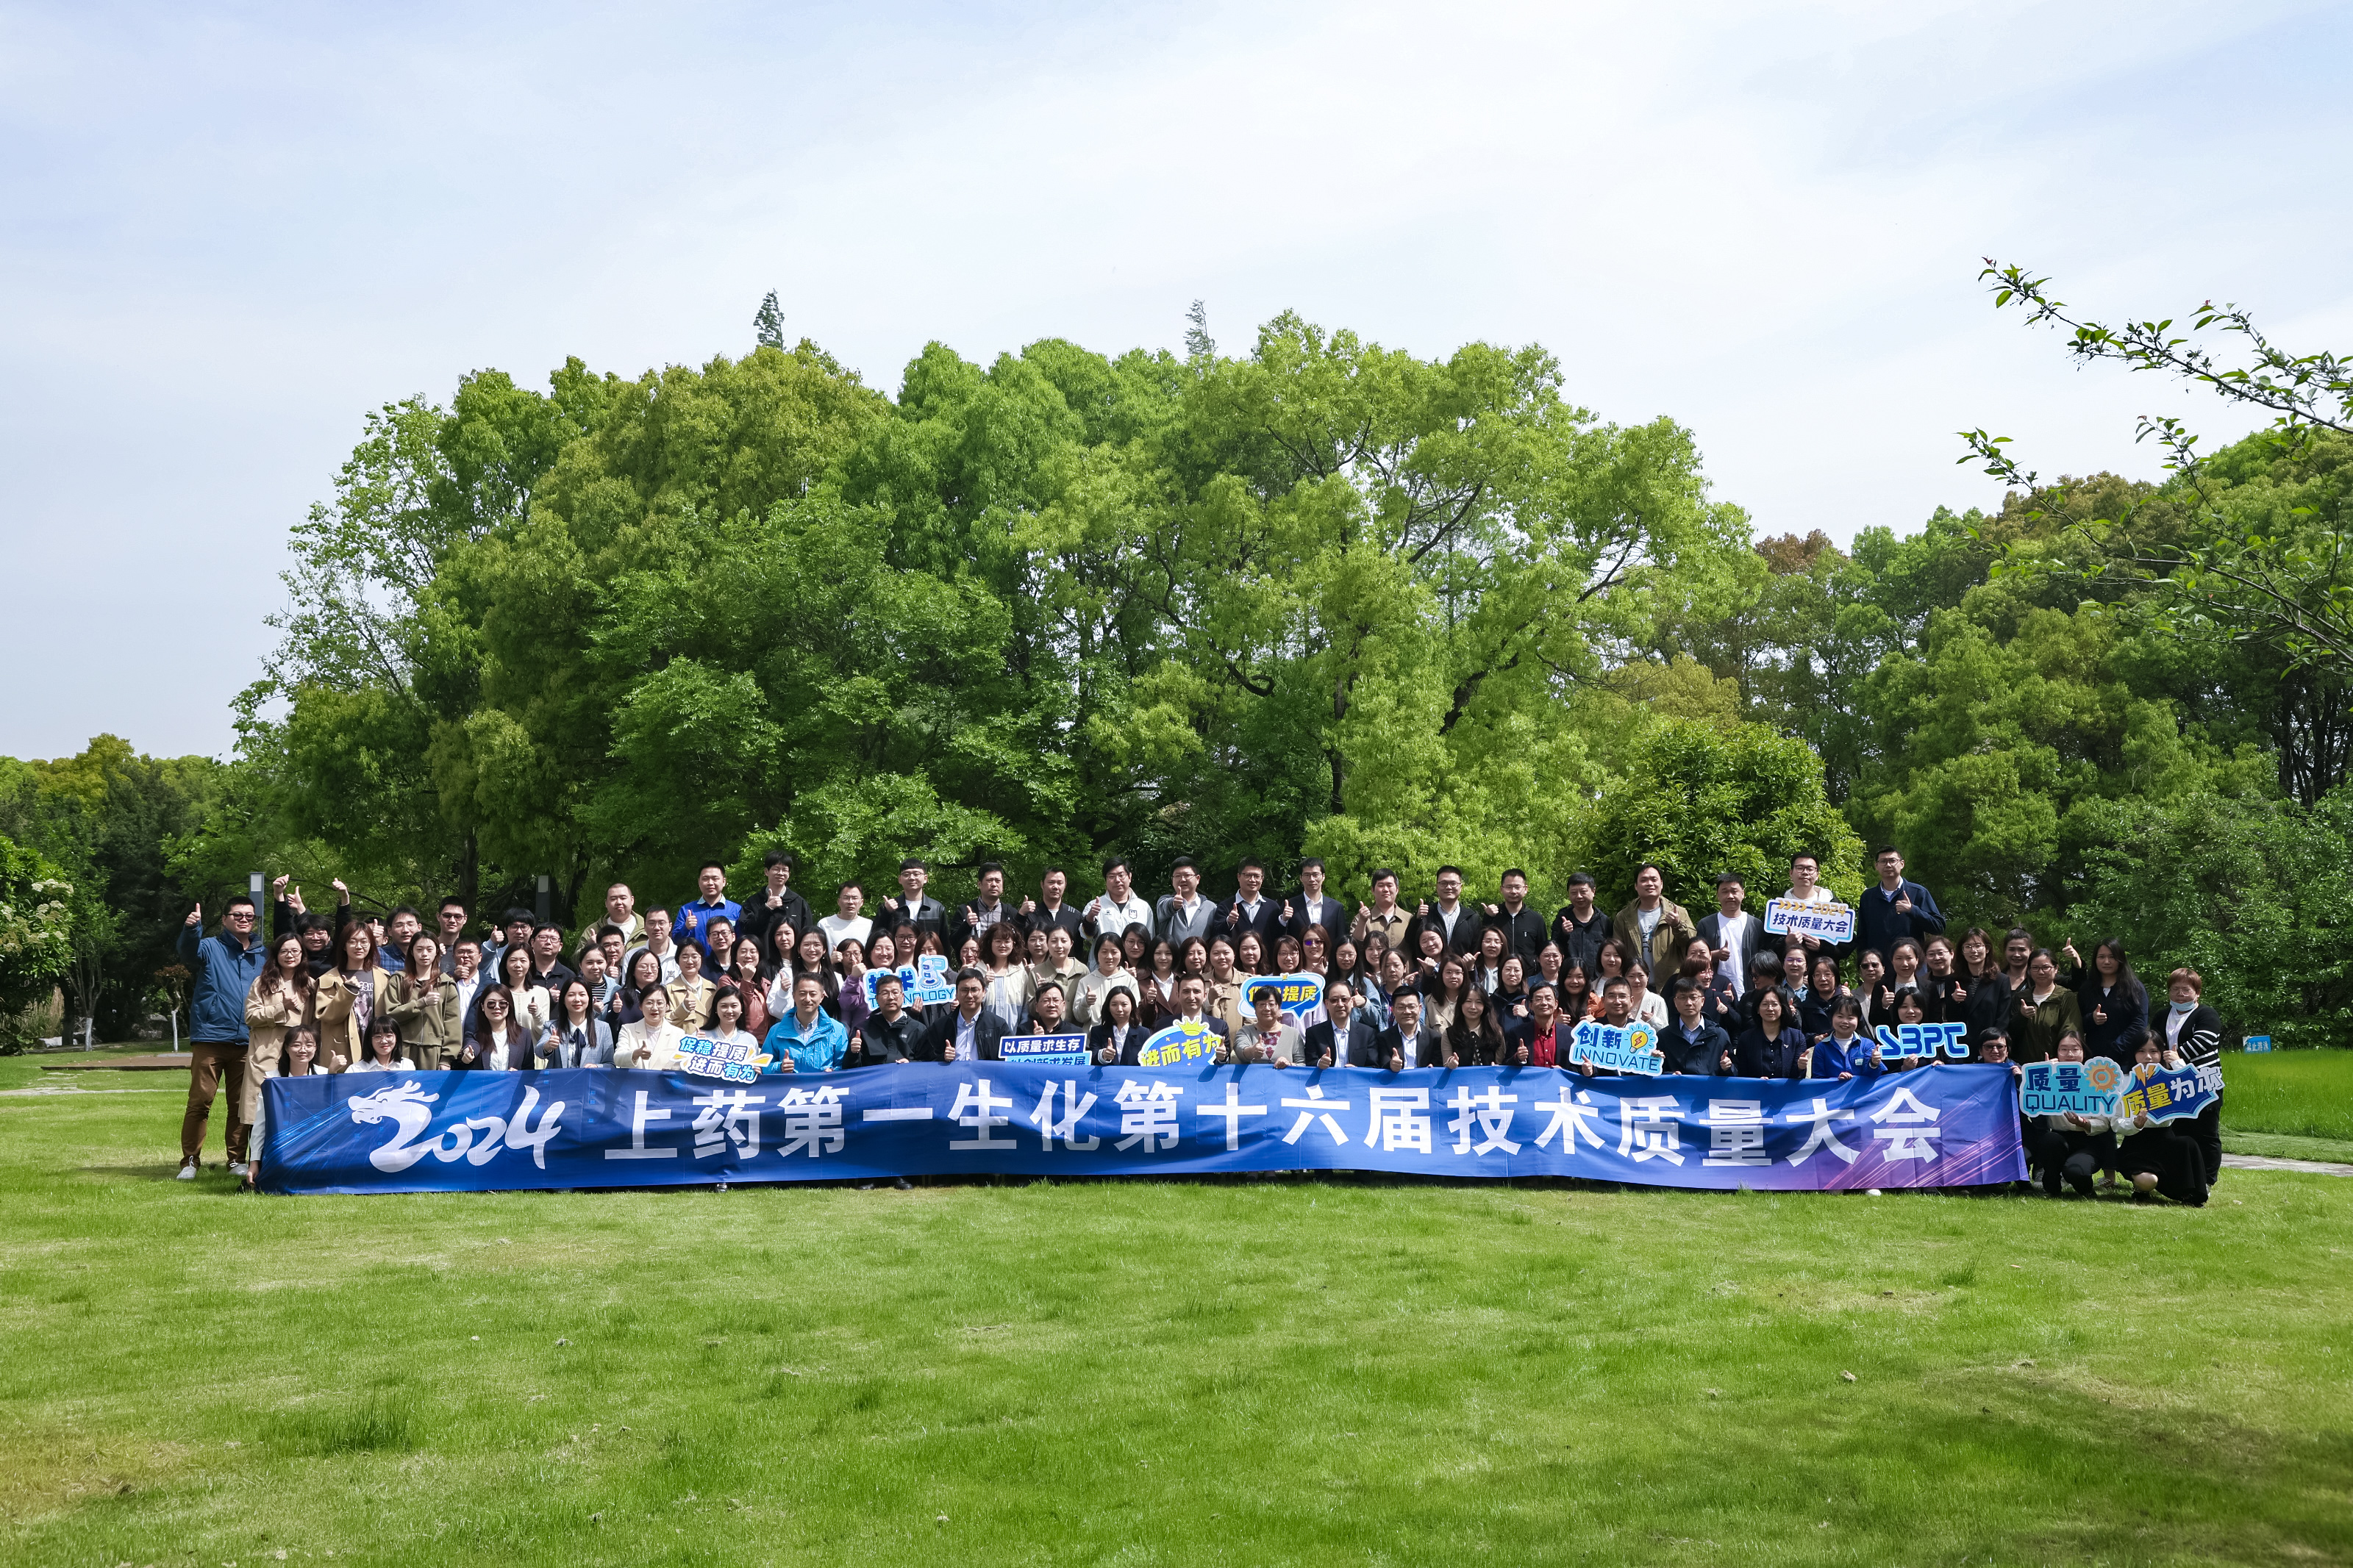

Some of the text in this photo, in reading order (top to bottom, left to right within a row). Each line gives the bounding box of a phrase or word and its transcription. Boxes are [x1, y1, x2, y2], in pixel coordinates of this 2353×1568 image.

[1812, 902, 1846, 917] 2024
[1772, 912, 1849, 933] 技术质量大会
[868, 988, 954, 1008] TNOLOGY
[1248, 985, 1318, 1002] 提质
[1004, 1039, 1080, 1053] 以质量求生存
[1577, 1025, 1622, 1049] 创新
[679, 1036, 748, 1061] 促稳提质
[1574, 1047, 1660, 1071] INNOVATE
[689, 1056, 756, 1081] 进而有为
[2027, 1067, 2082, 1093] 质量
[2026, 1094, 2115, 1111] QUALITY
[348, 1079, 1941, 1173] 2024 上药第一生化第十六届技术质量大会
